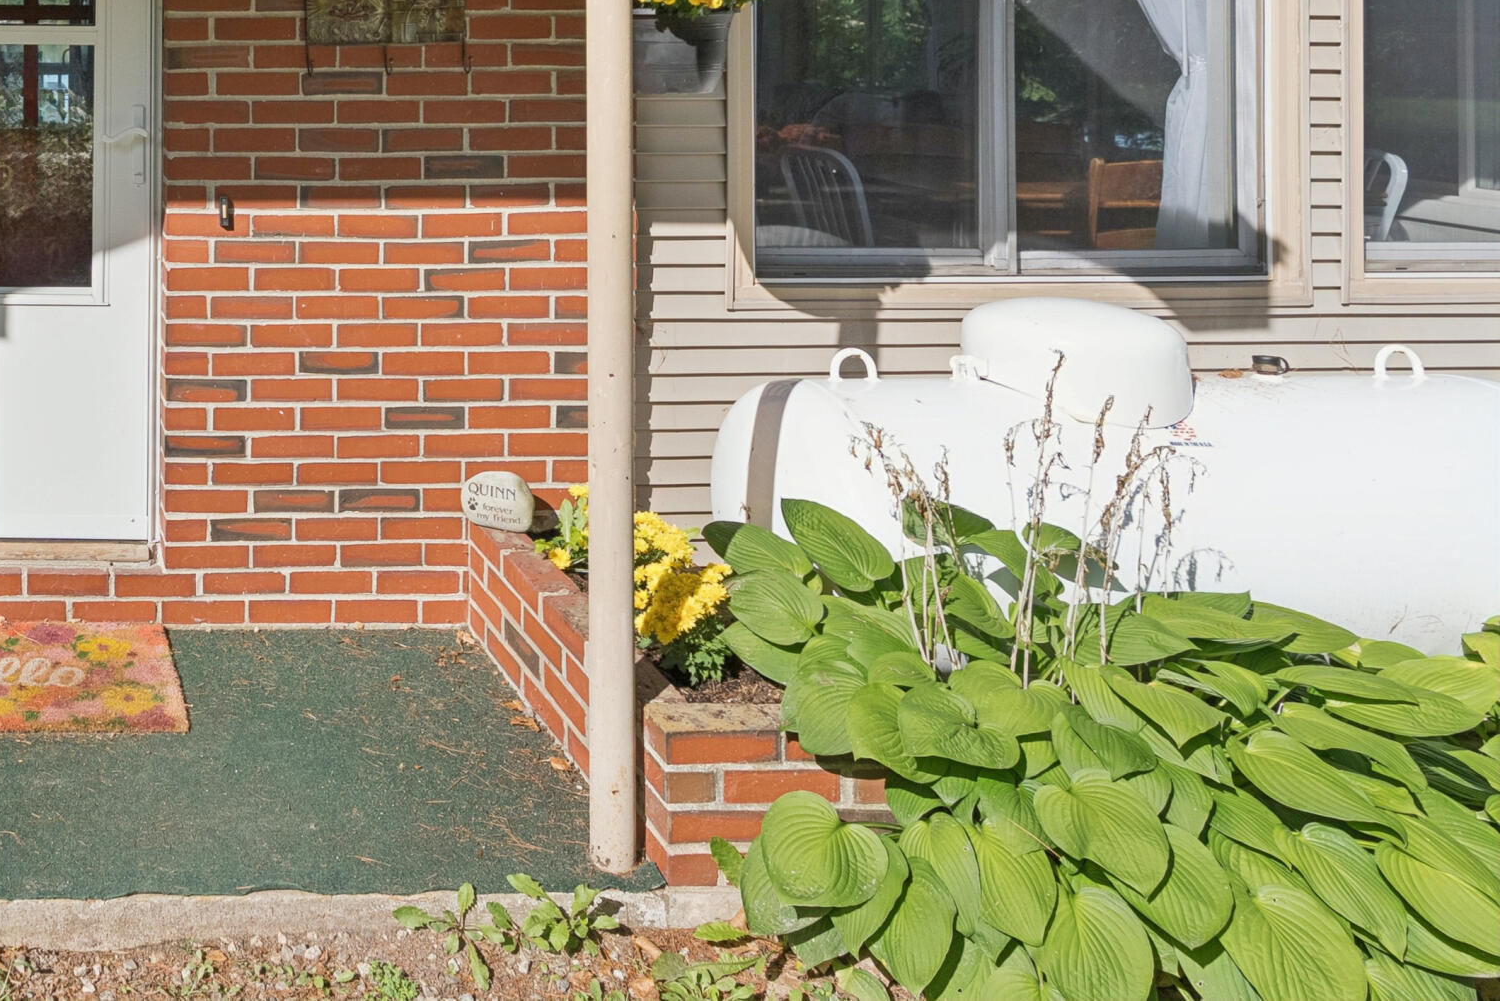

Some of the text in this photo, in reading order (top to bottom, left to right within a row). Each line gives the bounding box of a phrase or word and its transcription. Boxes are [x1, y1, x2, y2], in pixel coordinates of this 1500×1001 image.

[468, 482, 516, 501] QUINN
[482, 503, 514, 515] forever
[476, 512, 521, 524] my friend
